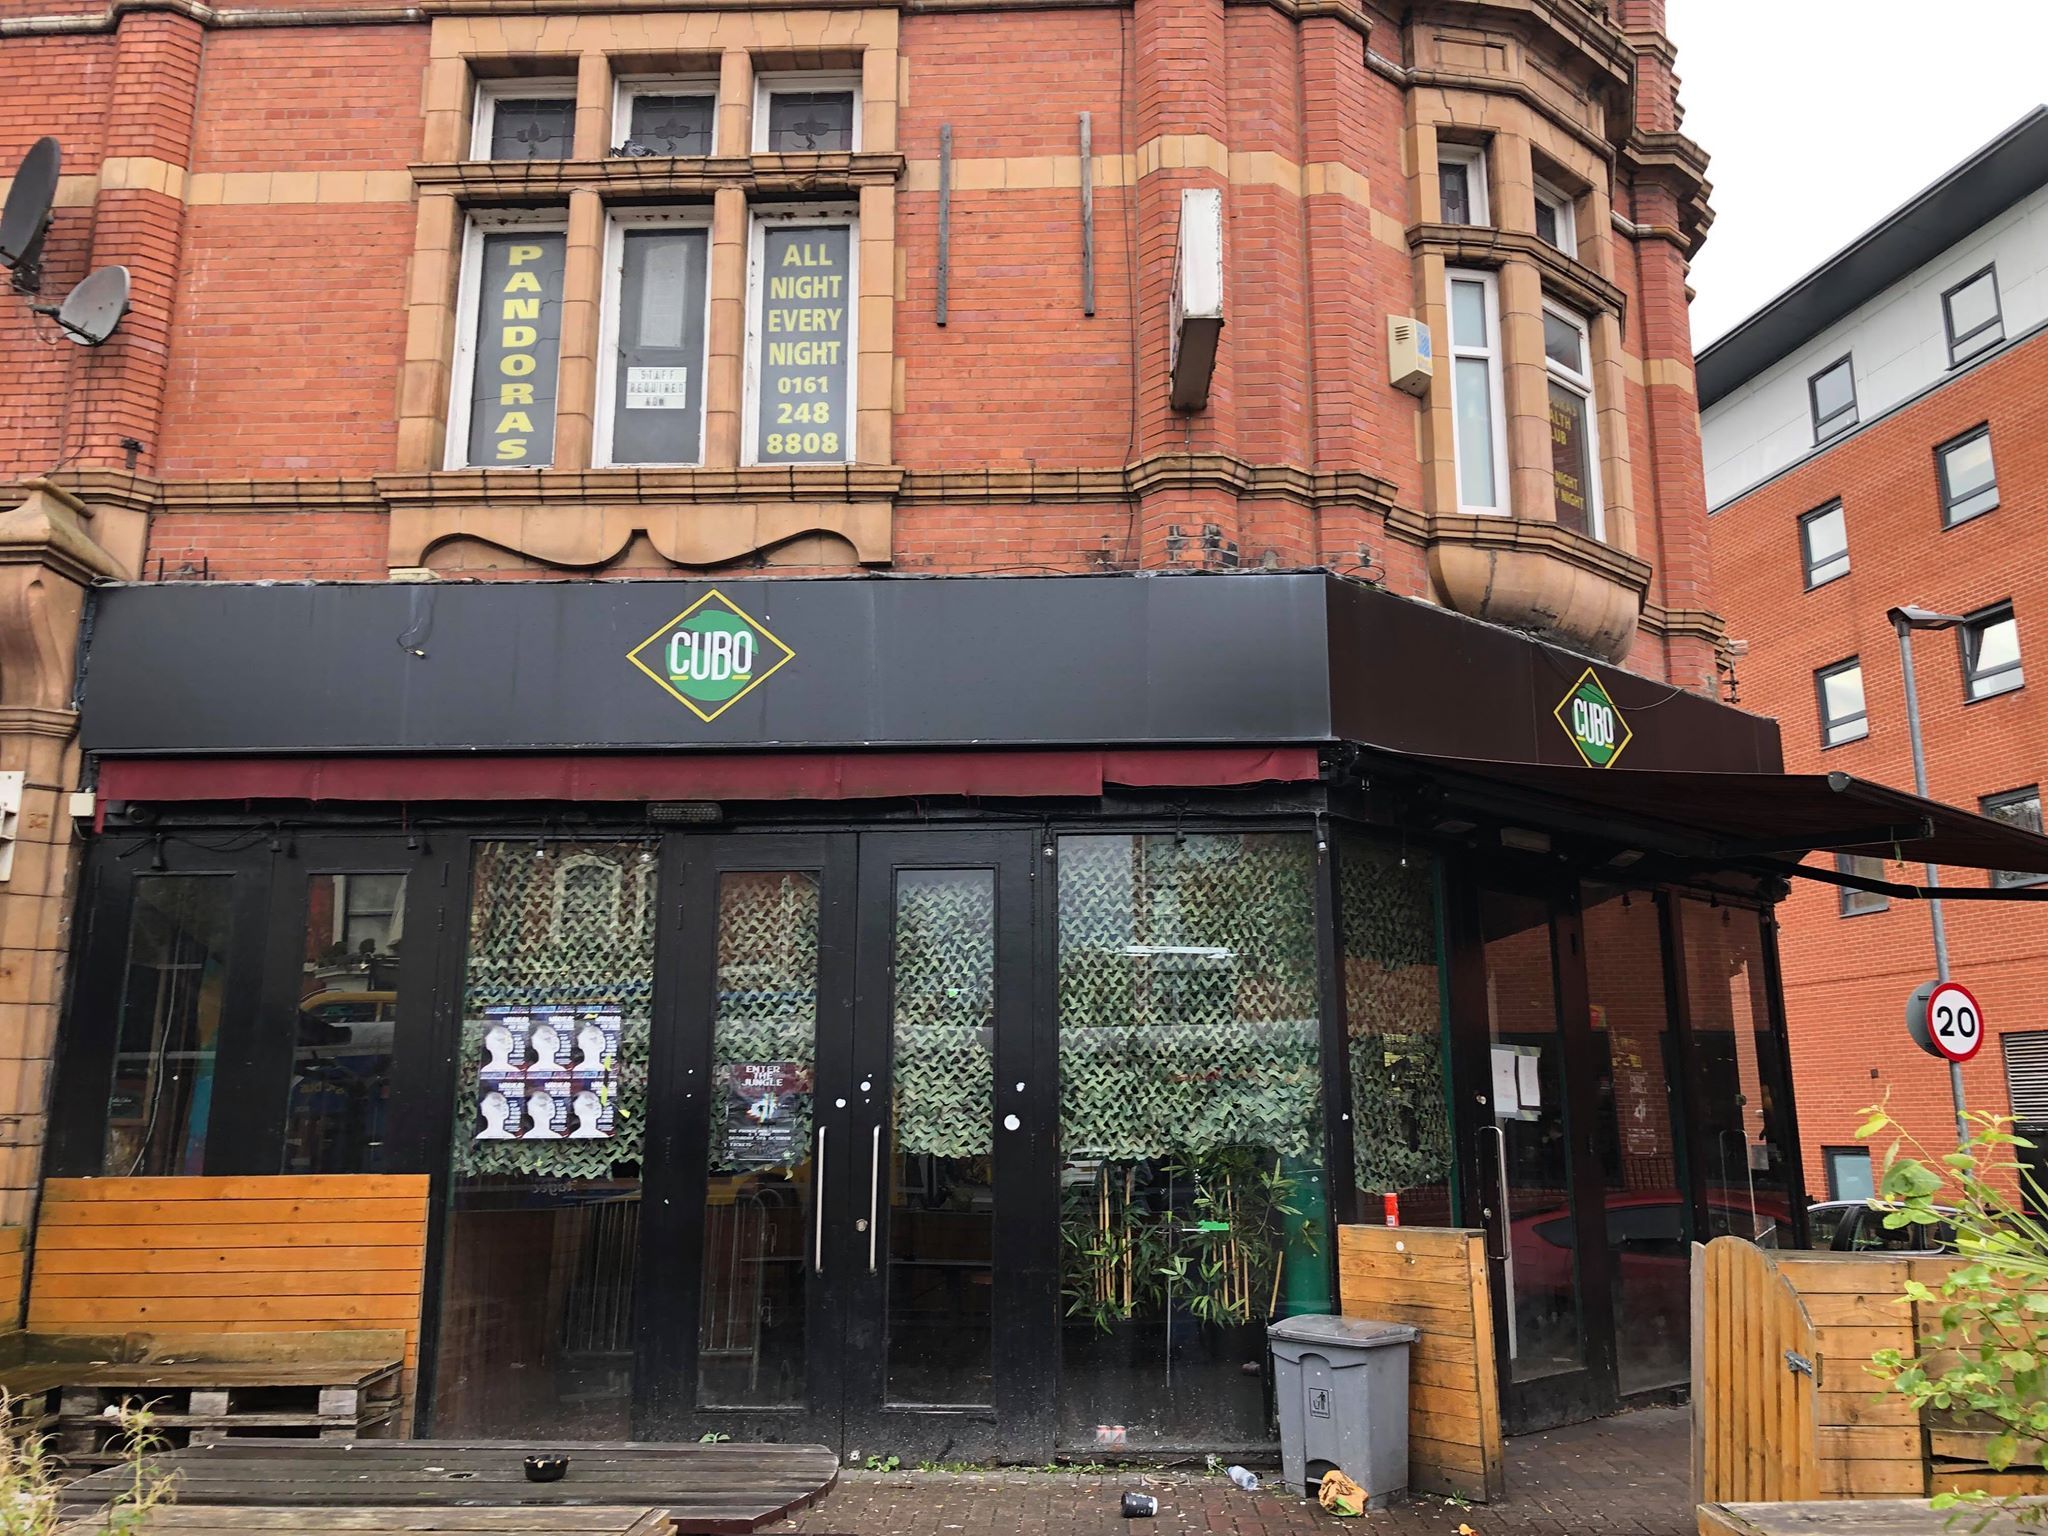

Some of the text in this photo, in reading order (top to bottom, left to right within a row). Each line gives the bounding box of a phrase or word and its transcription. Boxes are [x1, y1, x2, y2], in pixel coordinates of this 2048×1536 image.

[782, 243, 833, 266] ALL
[770, 275, 842, 299] NIGHT
[768, 308, 843, 332] EVERY
[495, 245, 543, 461] PANDORAS
[769, 341, 841, 366] NIGHT
[777, 376, 829, 394] 0161
[776, 401, 830, 424] 248
[766, 432, 840, 455] 8808
[670, 630, 753, 681] CUBO
[1573, 698, 1614, 747] CUBO
[1936, 1006, 1976, 1038] 20
[745, 1065, 781, 1073] ENTER
[753, 1072, 774, 1080] THE
[741, 1079, 784, 1087] JUNGLE
